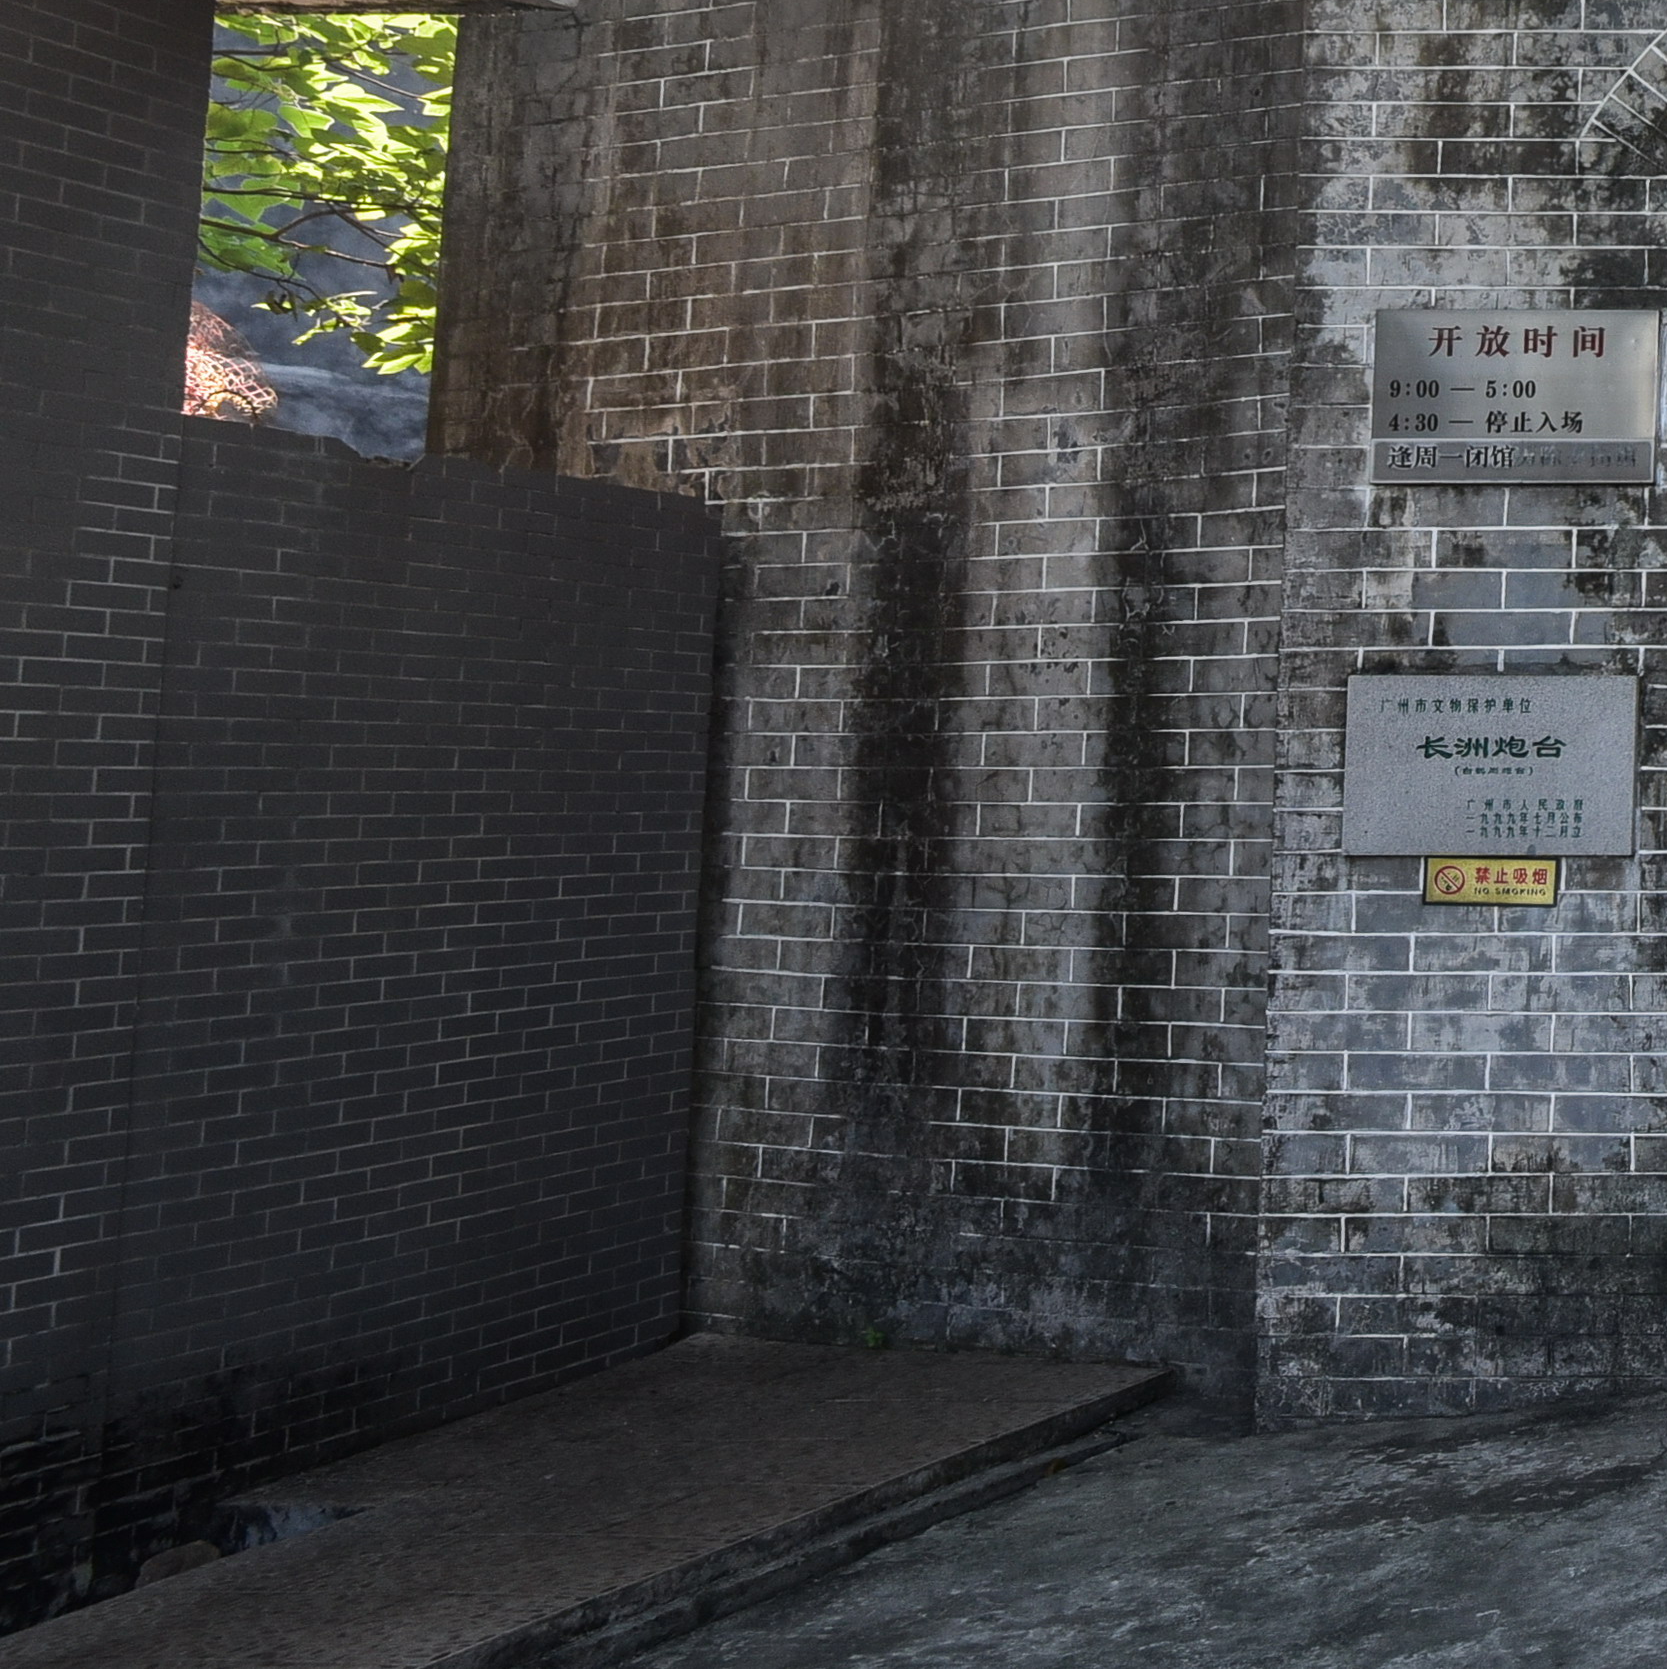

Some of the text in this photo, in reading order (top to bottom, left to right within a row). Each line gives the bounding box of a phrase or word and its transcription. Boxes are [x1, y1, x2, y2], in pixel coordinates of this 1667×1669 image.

[1428, 324, 1605, 358] 开放时间
[1389, 379, 1440, 399] 9:00
[1485, 379, 1537, 399] 5:00
[1388, 412, 1439, 432] 4:30
[1485, 410, 1584, 434] 停止入场
[1387, 445, 1515, 469] 逢周一闭馆
[1379, 697, 1533, 715] 广州市文物保护单位
[1415, 735, 1567, 759] 长洲炮台
[1466, 798, 1585, 811] 广州市人民政府
[1465, 812, 1583, 825] 一九九九年七月公布
[1465, 825, 1582, 839] 一九九九年十二月立
[1474, 866, 1548, 885] 禁止吸烟
[1474, 887, 1547, 897] NO SMOKING
